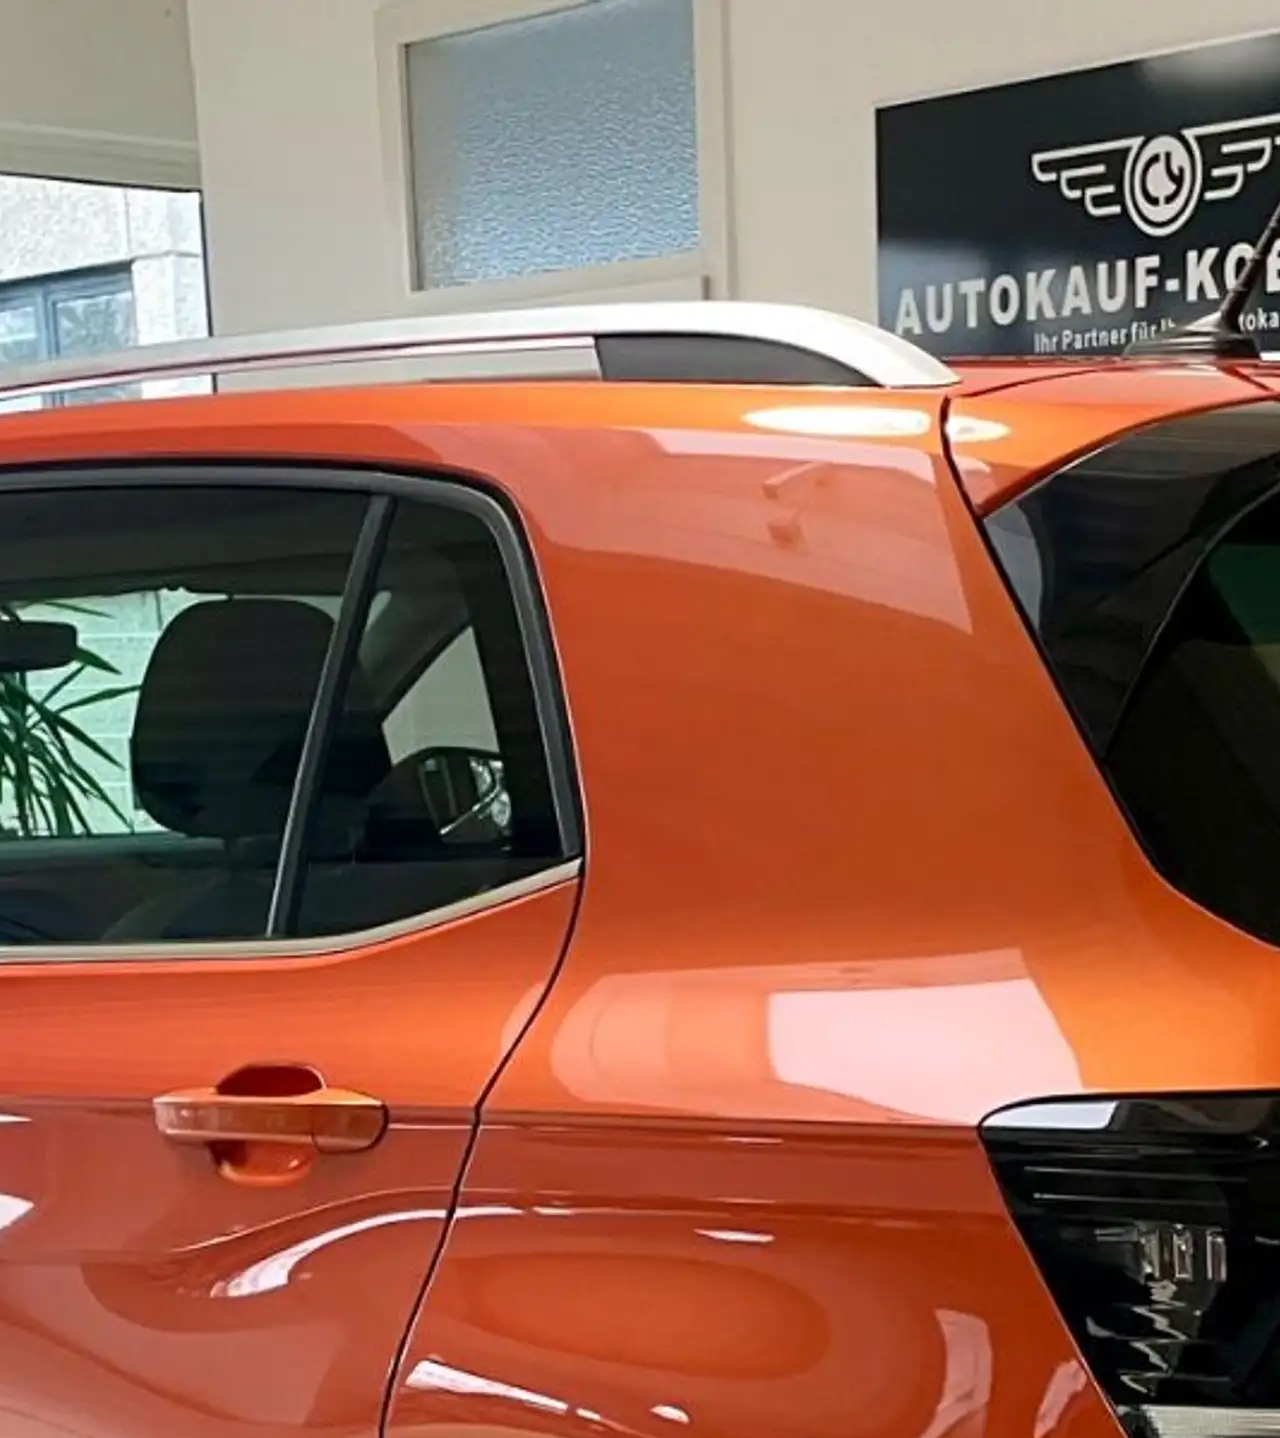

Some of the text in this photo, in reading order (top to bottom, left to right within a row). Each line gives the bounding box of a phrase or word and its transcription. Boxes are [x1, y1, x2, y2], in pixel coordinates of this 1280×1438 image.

[1033, 332, 1059, 354] Ihr
[1062, 328, 1128, 351] Partner
[1131, 319, 1157, 343] für
